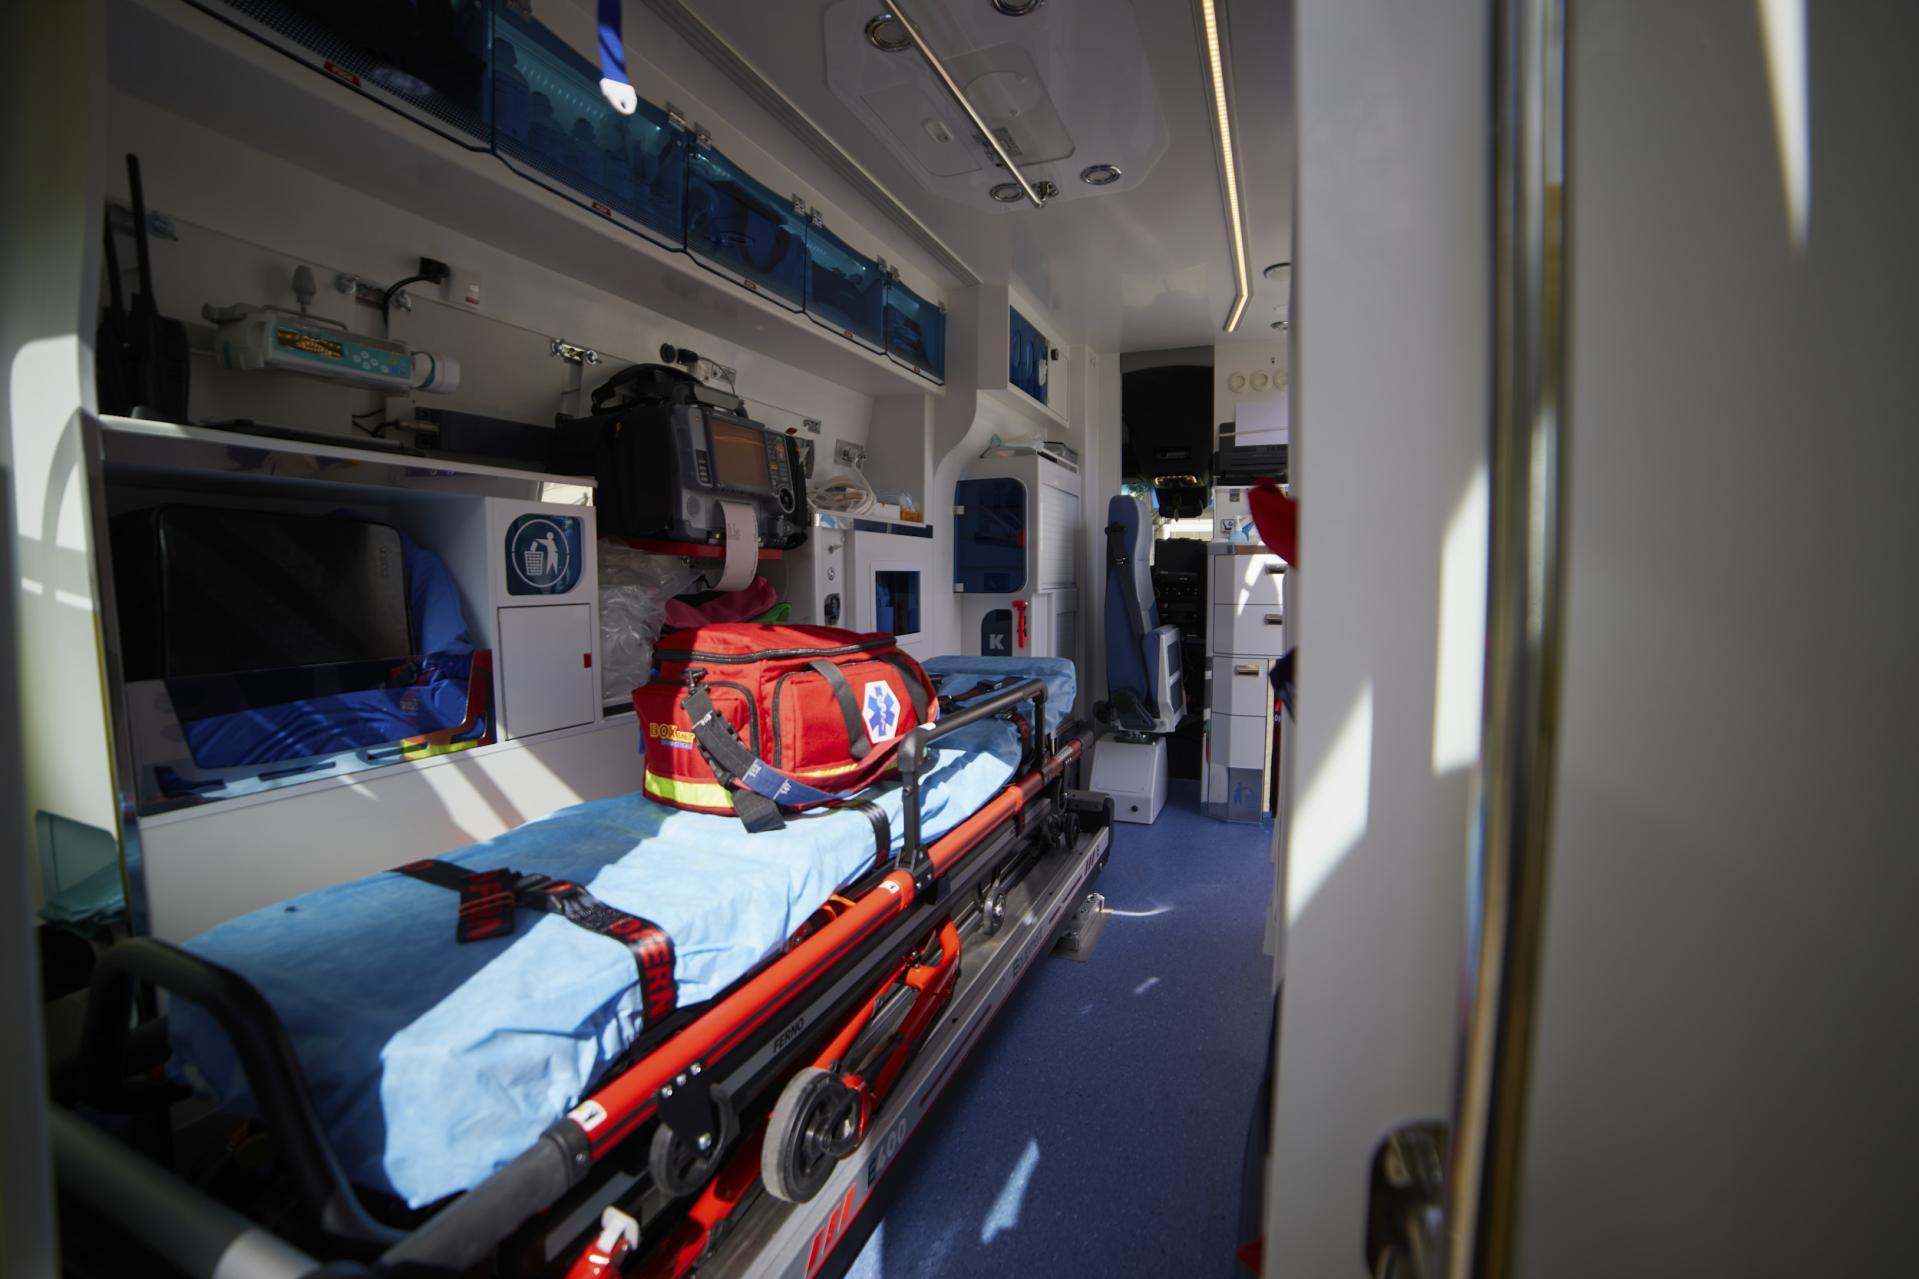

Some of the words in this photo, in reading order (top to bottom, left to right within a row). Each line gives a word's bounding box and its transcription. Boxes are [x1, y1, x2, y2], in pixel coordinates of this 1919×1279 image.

[989, 634, 1004, 650] K
[772, 1017, 805, 1054] FERNO
[868, 1117, 907, 1188] E400
